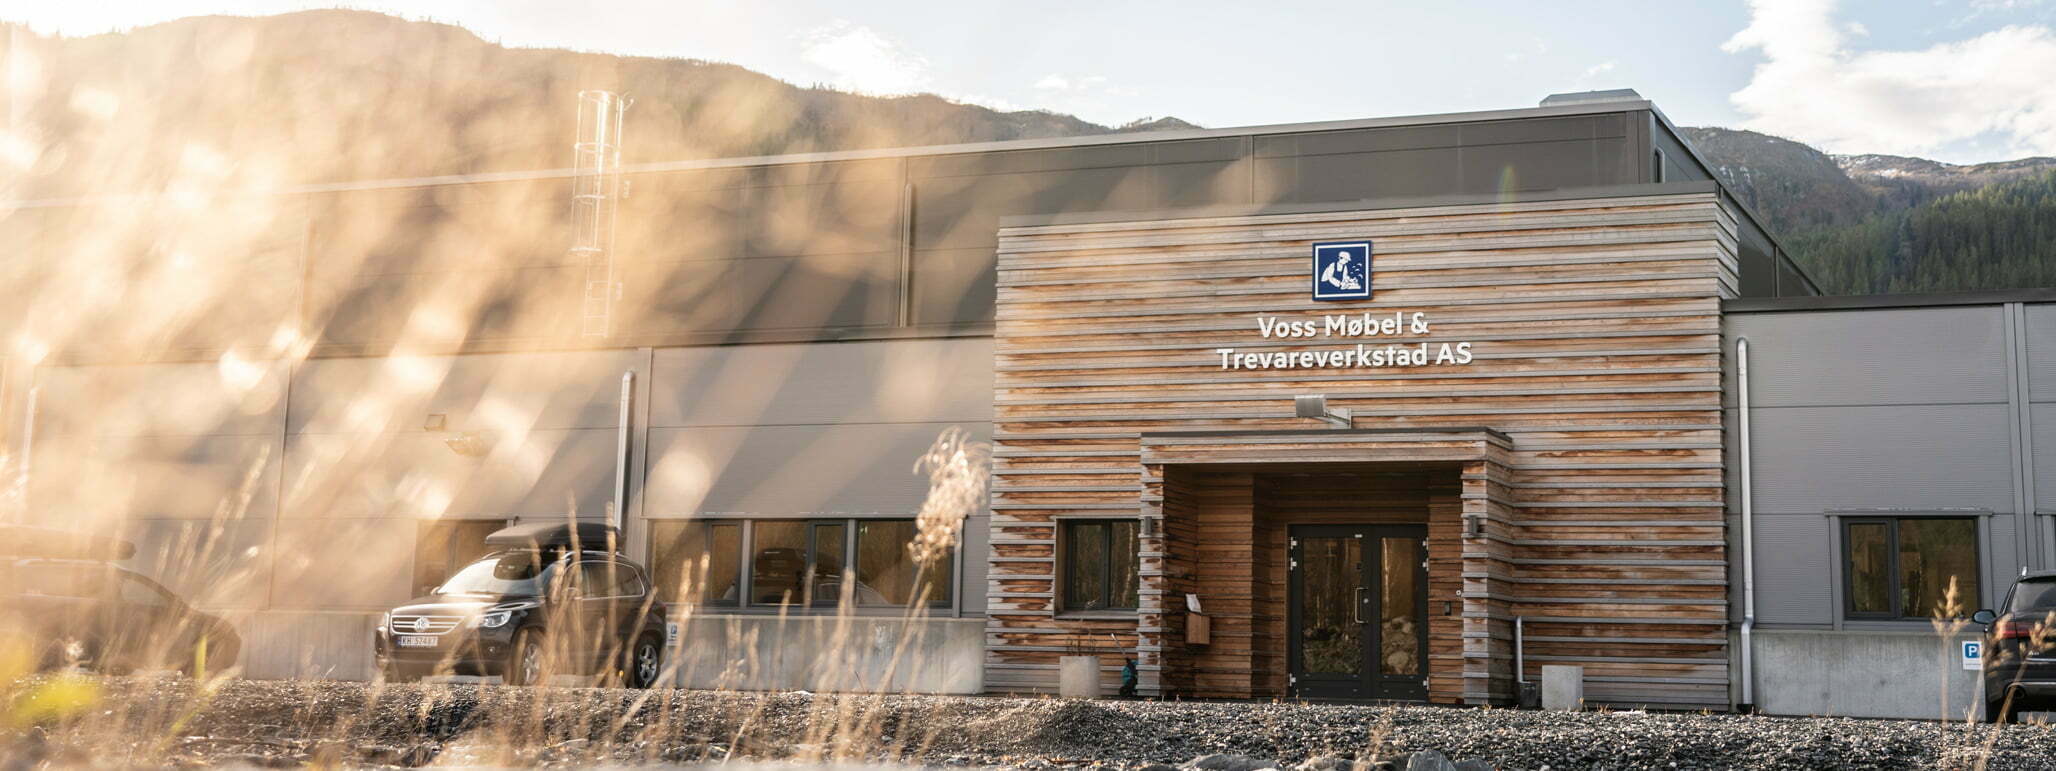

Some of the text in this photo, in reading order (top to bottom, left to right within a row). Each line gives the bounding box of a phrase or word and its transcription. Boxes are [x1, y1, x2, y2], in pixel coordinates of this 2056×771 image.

[1257, 311, 1430, 338] Voss Møbel &
[1216, 342, 1473, 370] Trevareverkstad AS
[1968, 645, 1978, 657] P
